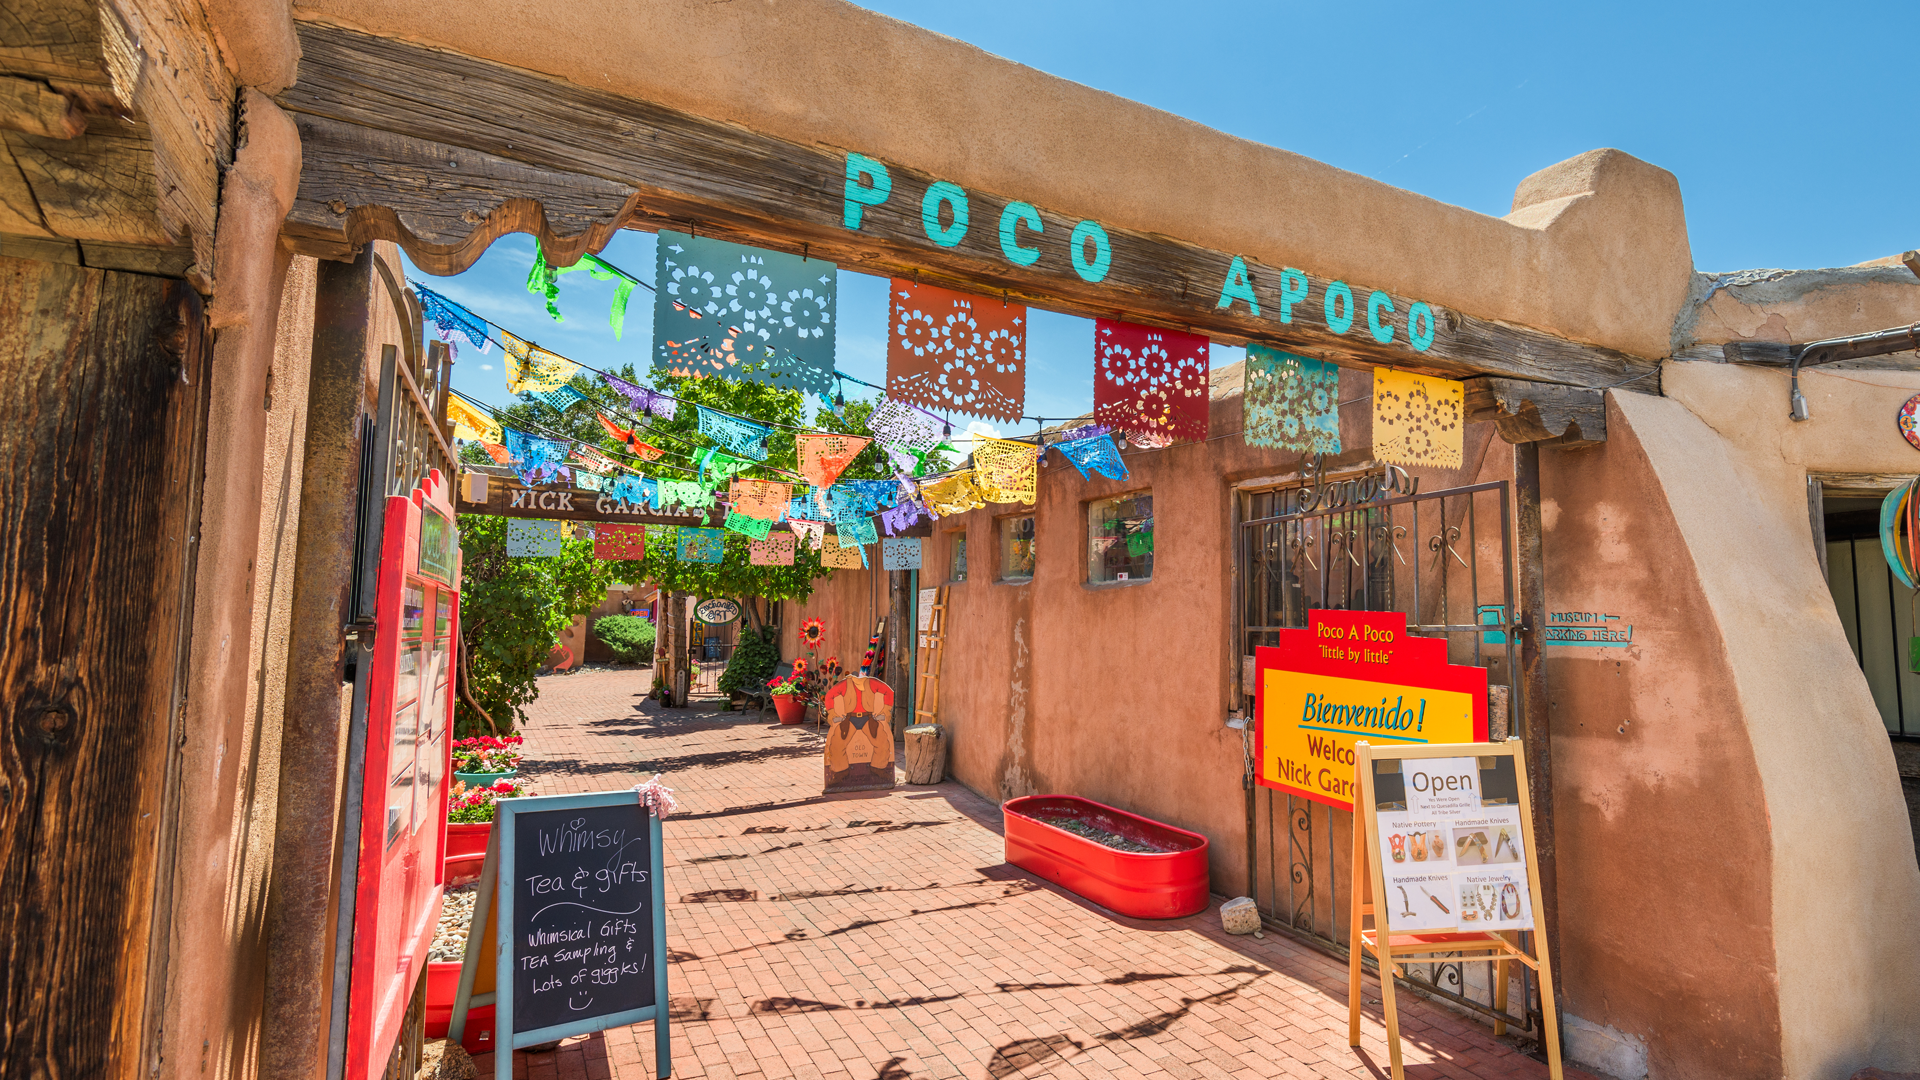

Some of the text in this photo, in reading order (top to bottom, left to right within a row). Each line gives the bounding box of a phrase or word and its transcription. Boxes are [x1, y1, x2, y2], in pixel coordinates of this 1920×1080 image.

[843, 152, 1112, 283] POCO
[509, 489, 575, 512] NICK
[1550, 612, 1597, 623] MUSEUM
[1318, 622, 1394, 643] Poco A Poco
[1546, 624, 1633, 641] ARKING HERE!
[1319, 644, 1393, 665] "little by little"
[1302, 692, 1426, 732] Bienvenido!
[1307, 733, 1355, 766] Welco
[1277, 756, 1312, 787] Nick
[1412, 771, 1473, 796] Open
[1414, 820, 1436, 828] Pottery
[1455, 818, 1488, 826] Handmade
[540, 822, 641, 873] Whimsy
[525, 874, 565, 896] Tea
[571, 866, 589, 898] &
[1393, 874, 1448, 884] Handmade Knives
[1488, 874, 1512, 882] Jewelry
[528, 918, 637, 947] Whimsical Gifts
[521, 955, 549, 971] TEA
[554, 940, 616, 964] Sampling
[533, 974, 563, 994] Lots
